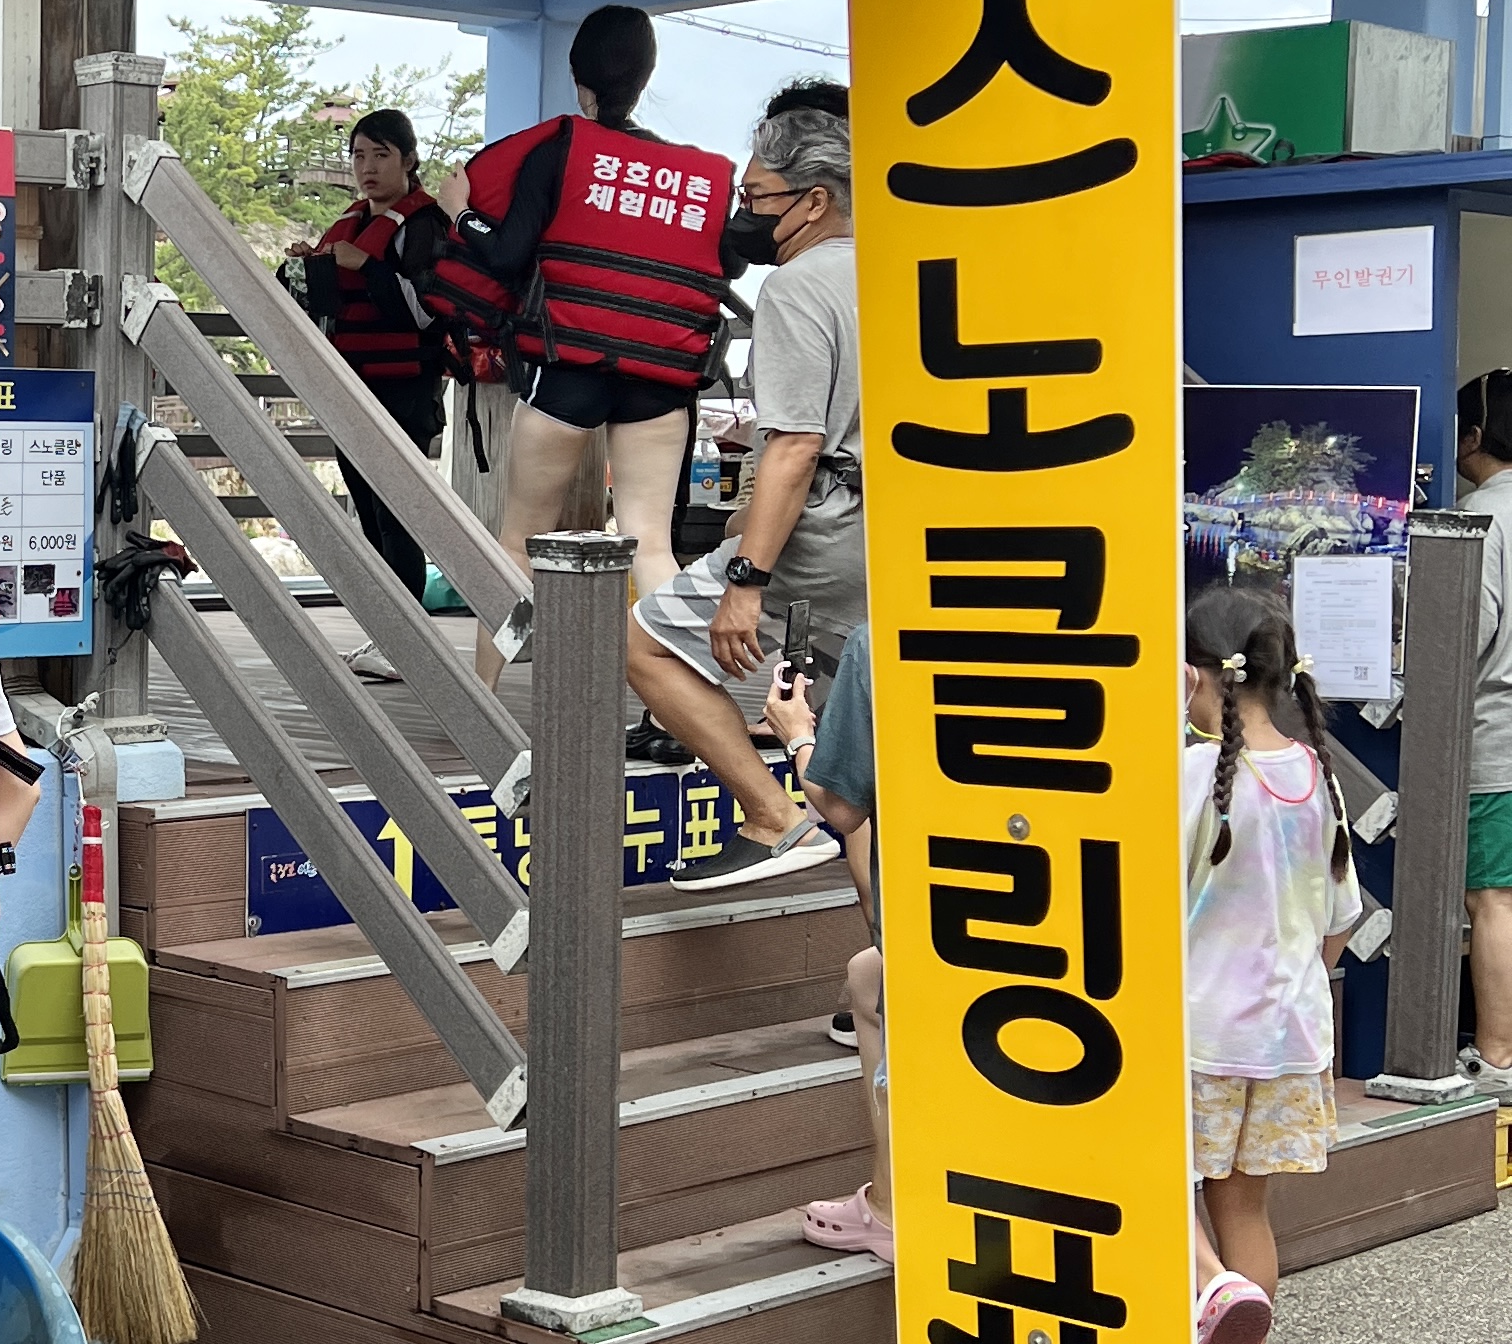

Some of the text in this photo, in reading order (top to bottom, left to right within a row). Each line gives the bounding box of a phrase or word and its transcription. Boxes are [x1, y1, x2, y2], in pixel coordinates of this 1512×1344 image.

[592, 153, 712, 203] 장호어촌
[584, 182, 707, 233] 체험마을
[1311, 263, 1415, 291] 무인발권기
[28, 438, 79, 456] 스노클링
[40, 469, 67, 487] 단품
[28, 533, 78, 552] 6,000원
